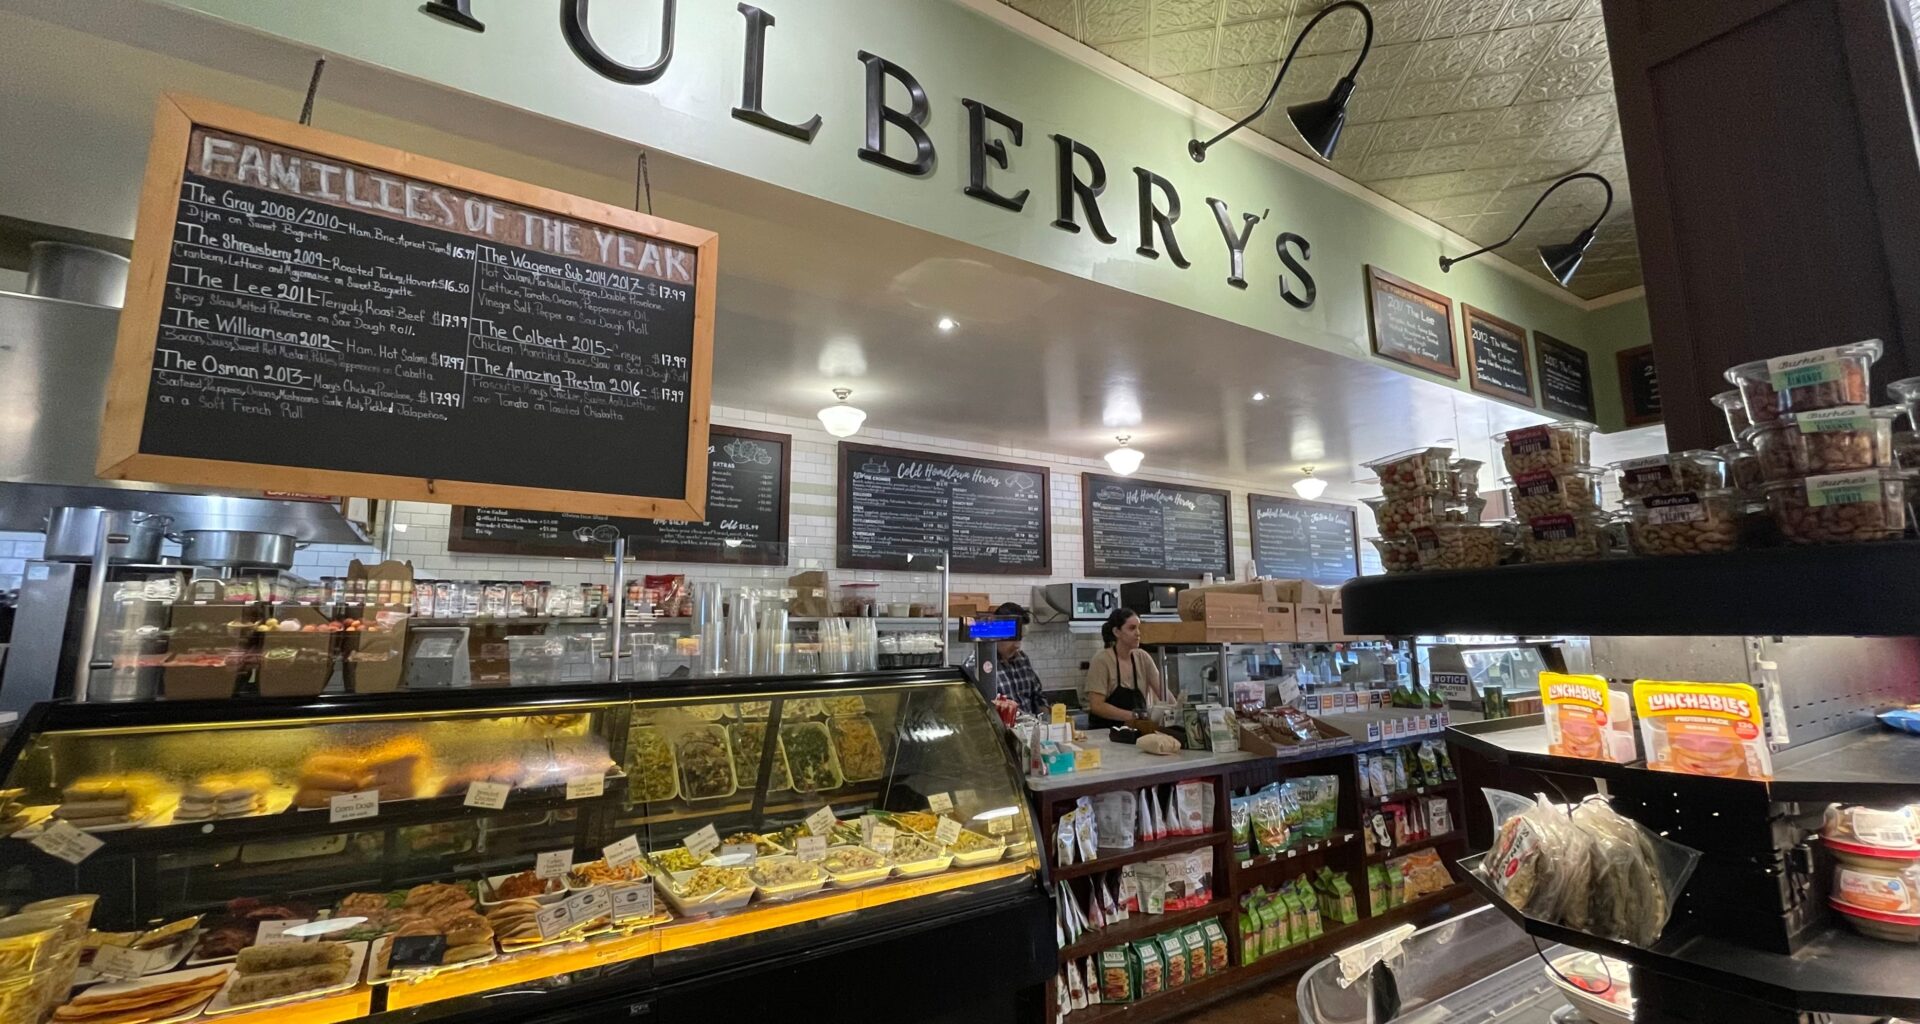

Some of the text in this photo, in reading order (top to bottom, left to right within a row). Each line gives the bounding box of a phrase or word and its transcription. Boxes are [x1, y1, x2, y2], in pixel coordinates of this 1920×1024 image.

[424, 0, 1318, 310] ULBERRY'S
[183, 181, 216, 205] The
[222, 190, 256, 217] Gray
[202, 135, 690, 281] FAMILIES OF THE YEAR
[186, 204, 277, 231] Dijon on Sweet
[177, 221, 219, 247] The
[332, 256, 373, 277] Roasted
[438, 278, 470, 294] $16.50
[228, 254, 264, 271] Lettuce
[268, 264, 283, 275] and
[334, 277, 344, 287] on
[478, 244, 508, 263] The
[510, 250, 563, 278] Wagener
[564, 263, 584, 281] Sub
[647, 282, 686, 302] $17.99
[171, 263, 223, 289] The
[233, 273, 273, 297] Lee
[365, 298, 395, 318] Roast
[395, 305, 426, 323] Beef
[429, 310, 468, 328] $17.99
[481, 263, 499, 277] Hot
[600, 288, 626, 303] Double
[175, 287, 204, 306] Spicy
[317, 313, 329, 323] on
[353, 316, 386, 335] Dough
[626, 320, 649, 335] Roll
[167, 306, 209, 330] The
[215, 313, 298, 344] Williamson
[379, 344, 398, 360] Hot
[430, 352, 465, 370] $17.99
[471, 317, 507, 339] The
[512, 324, 568, 348] Colbert
[651, 352, 687, 368] $17.99
[1472, 328, 1488, 343] 2012
[156, 348, 197, 370] The
[201, 354, 258, 379] Osman
[417, 389, 461, 407] $17.99
[467, 355, 501, 376] The
[505, 361, 564, 391] Amazing
[561, 370, 606, 391] Preston
[650, 386, 684, 403] $17.99
[159, 394, 303, 419] on a Soft French Roll
[495, 391, 529, 409] Tomato
[534, 402, 545, 411] on
[896, 462, 1001, 488] Cold Hometown Heroes
[1126, 490, 1139, 505] Hot
[1433, 674, 1467, 684] NOTICE
[1548, 682, 1604, 707] LUNCHABLES
[1646, 692, 1752, 719] LUNCHABLES
